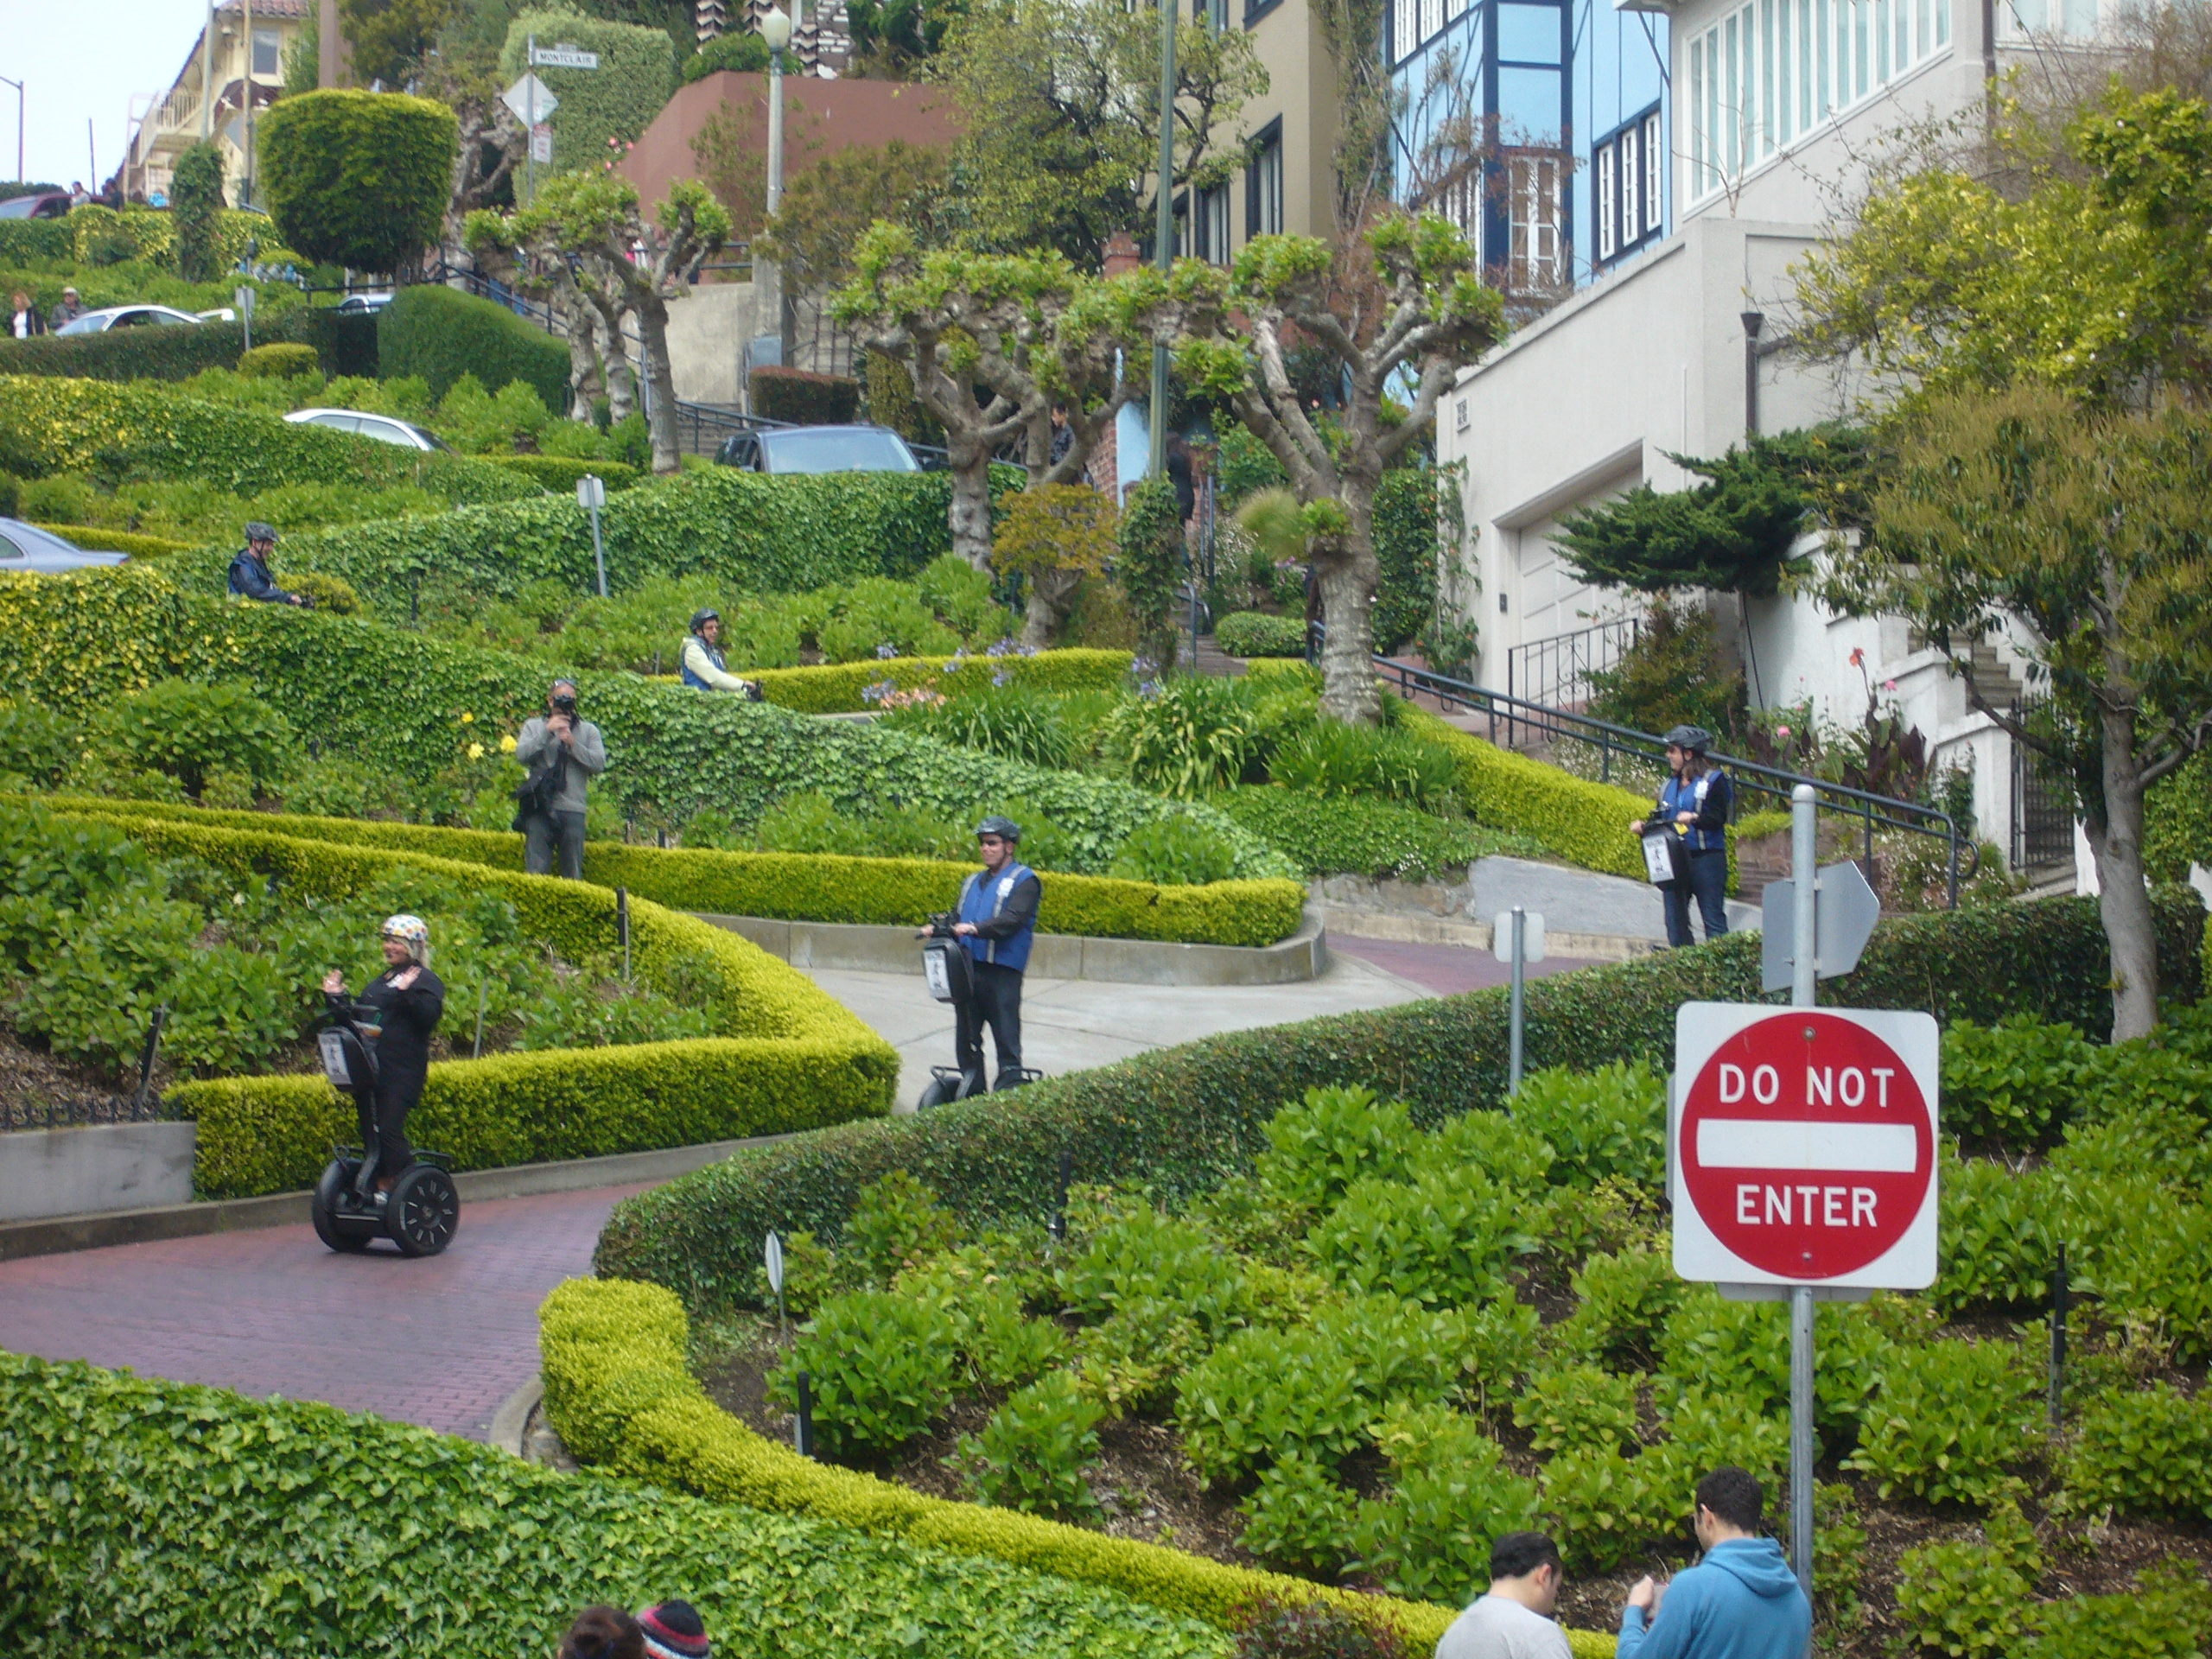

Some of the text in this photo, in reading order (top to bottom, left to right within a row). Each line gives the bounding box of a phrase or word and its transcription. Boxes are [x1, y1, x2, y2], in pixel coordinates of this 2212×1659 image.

[540, 53, 591, 64] MONTCLAIR
[1719, 1063, 1894, 1108] DO NOT
[1737, 1184, 1878, 1227] ENTER
